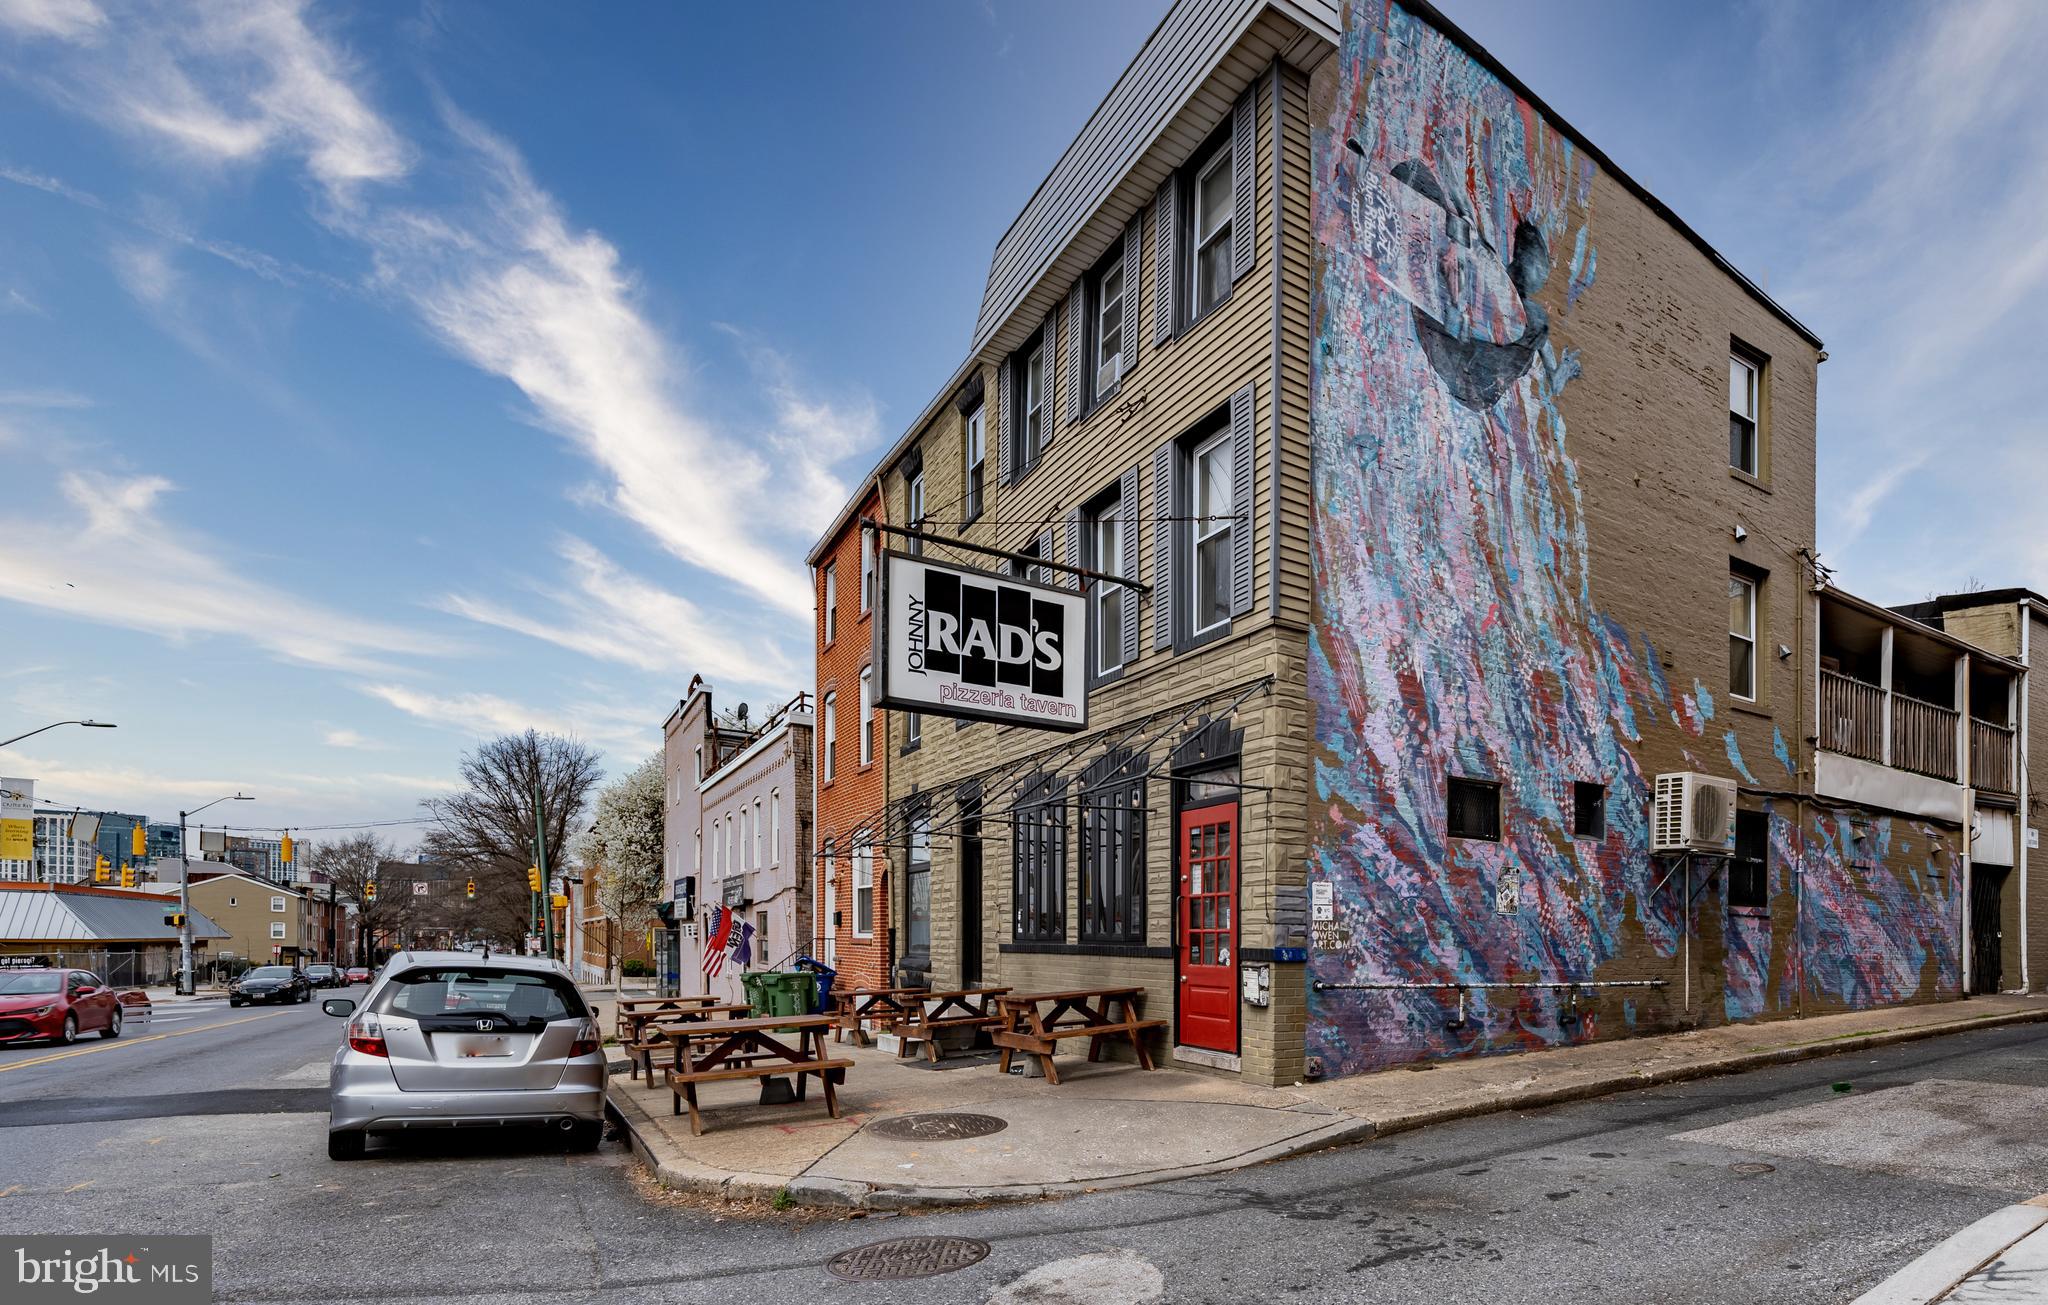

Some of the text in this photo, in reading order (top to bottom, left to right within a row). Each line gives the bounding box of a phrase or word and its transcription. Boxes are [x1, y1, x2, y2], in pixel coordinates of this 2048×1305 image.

[1363, 171, 1379, 257] Blue Ribbon
[1376, 194, 1396, 262] Pabst
[908, 593, 928, 677] JOHNNY
[926, 608, 1062, 672] RAD'S
[939, 682, 1077, 717] pizzeria tavern
[1311, 921, 1343, 931] MICHA
[1311, 930, 1340, 940] OWEN
[0, 957, 11, 965] got
[1311, 940, 1351, 950] ART.COM
